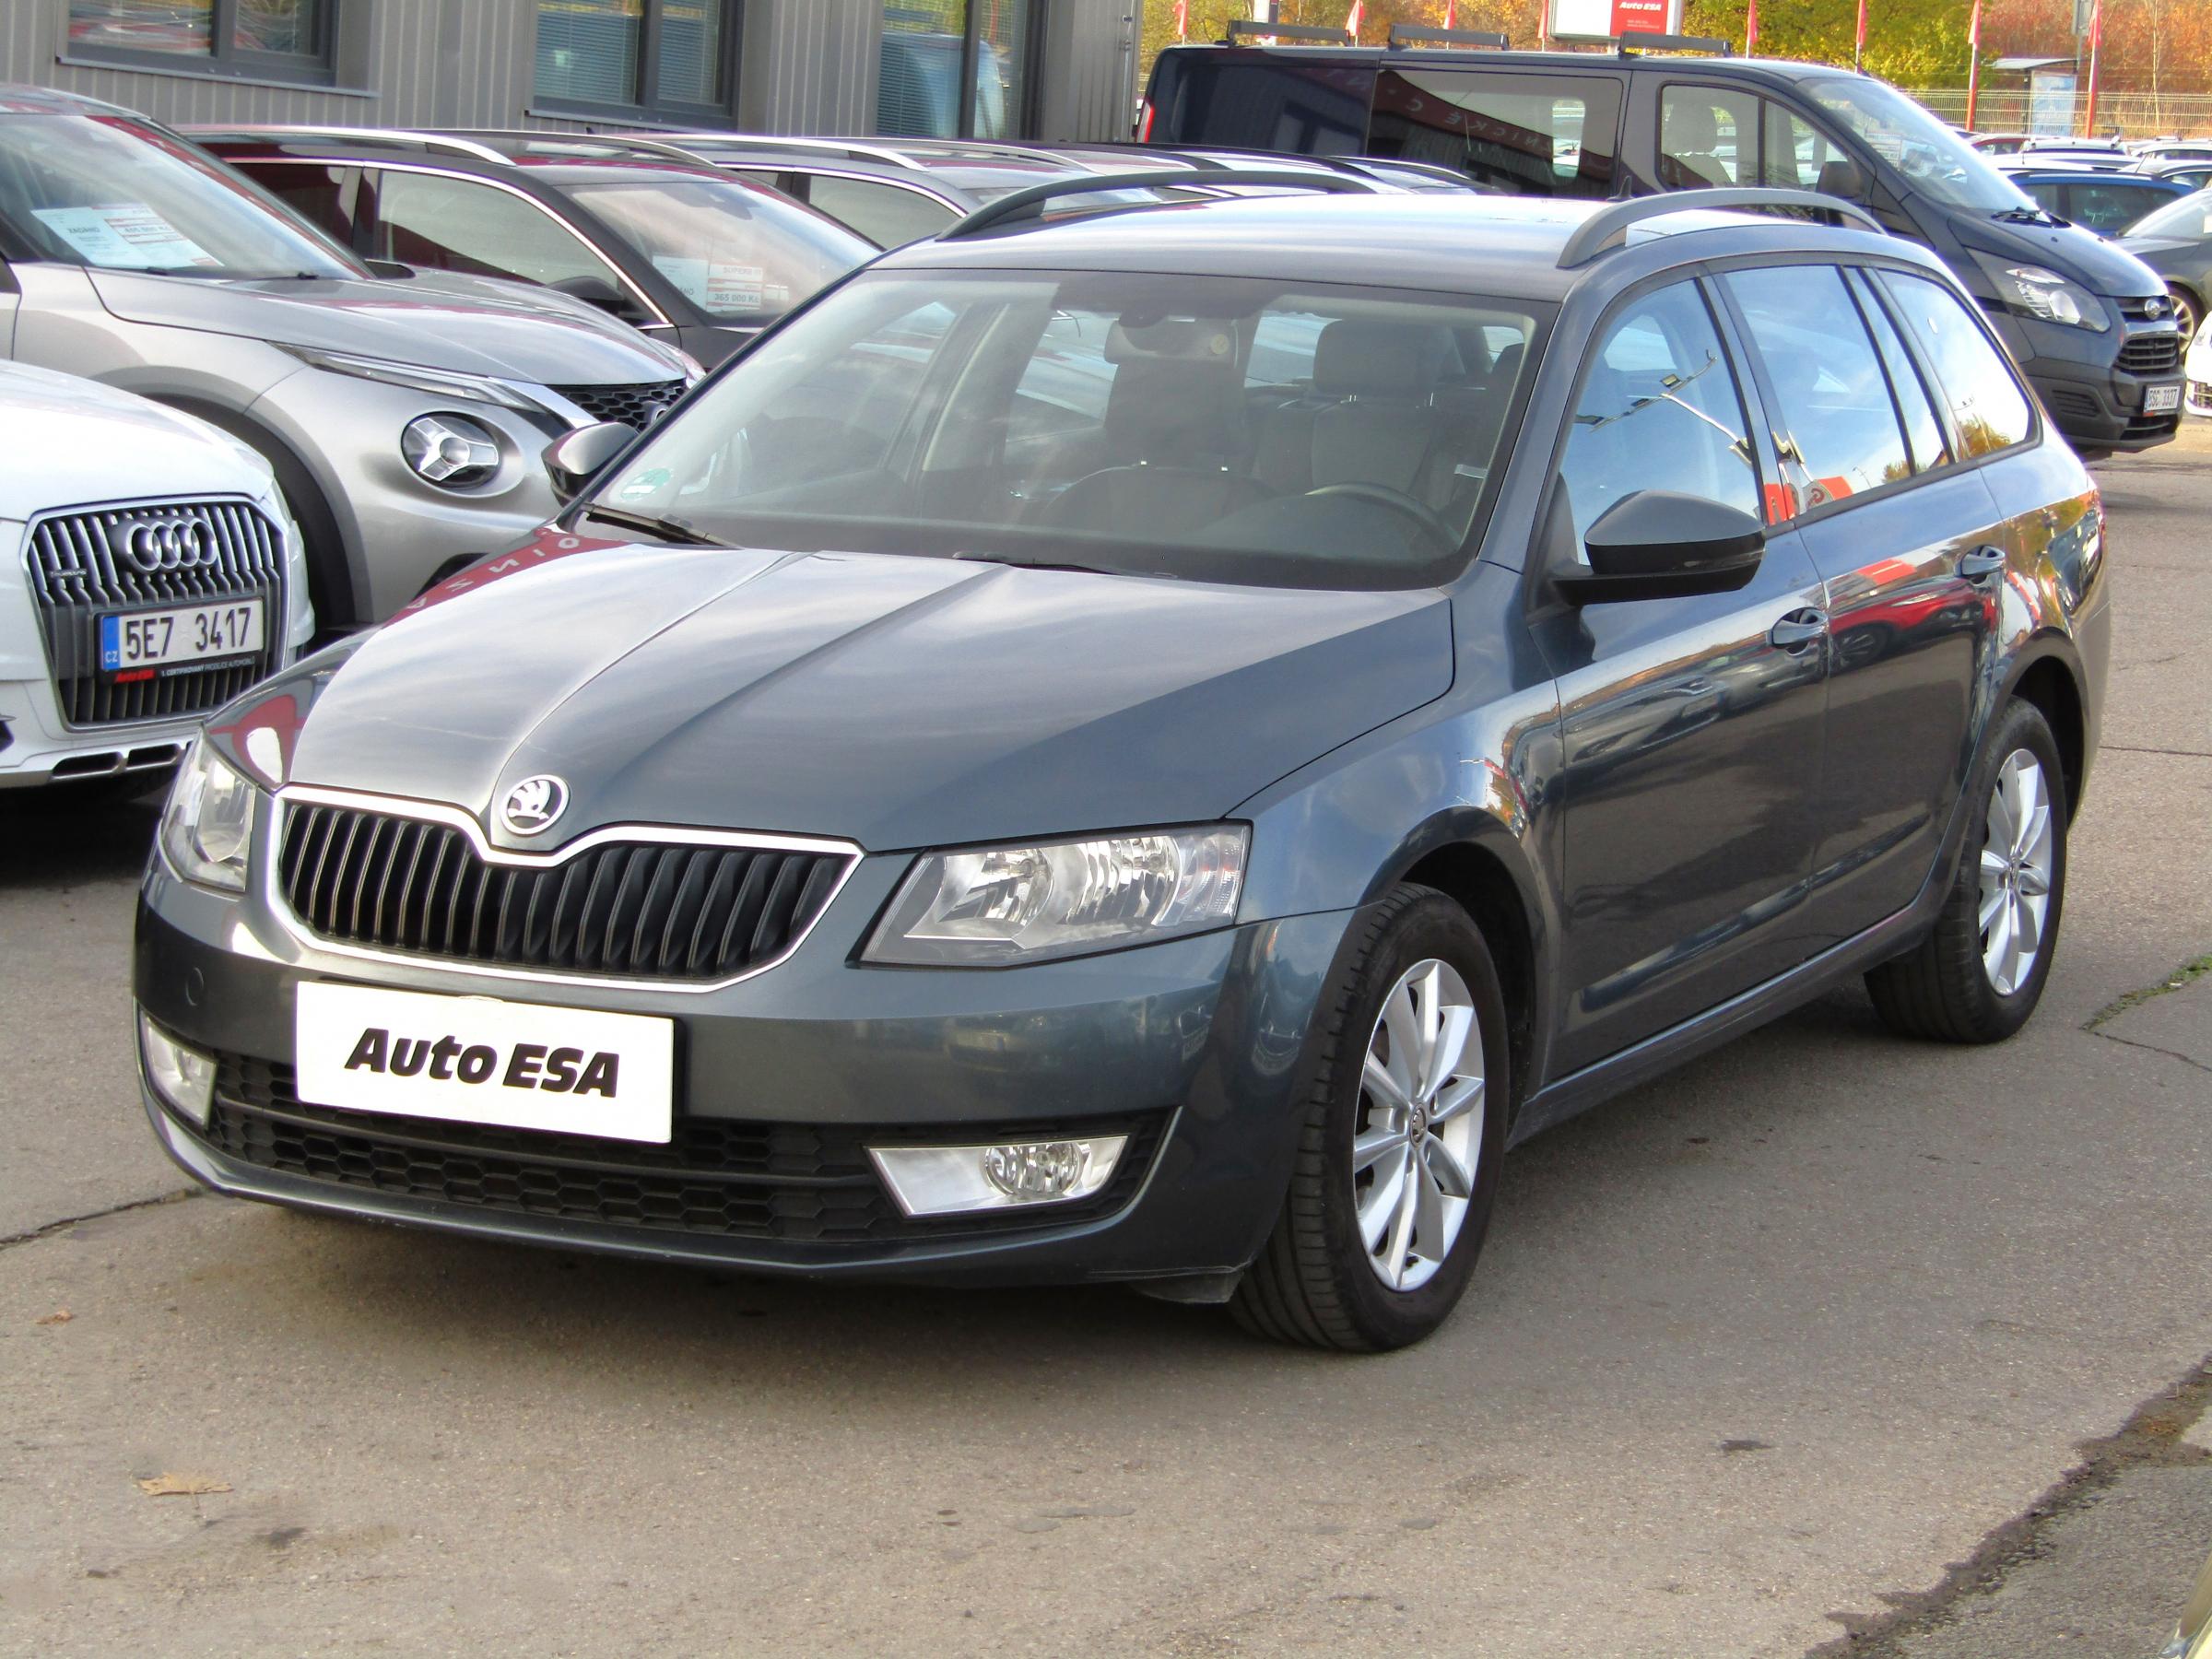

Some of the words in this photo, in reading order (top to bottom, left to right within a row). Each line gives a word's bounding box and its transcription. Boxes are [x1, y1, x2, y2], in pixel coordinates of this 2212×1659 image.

[1618, 2, 1642, 10] Auto
[126, 616, 174, 661] 5E7
[195, 606, 252, 653] 3417
[105, 651, 118, 663] CZ
[344, 1028, 498, 1084] Auto
[502, 1043, 619, 1098] ESA
